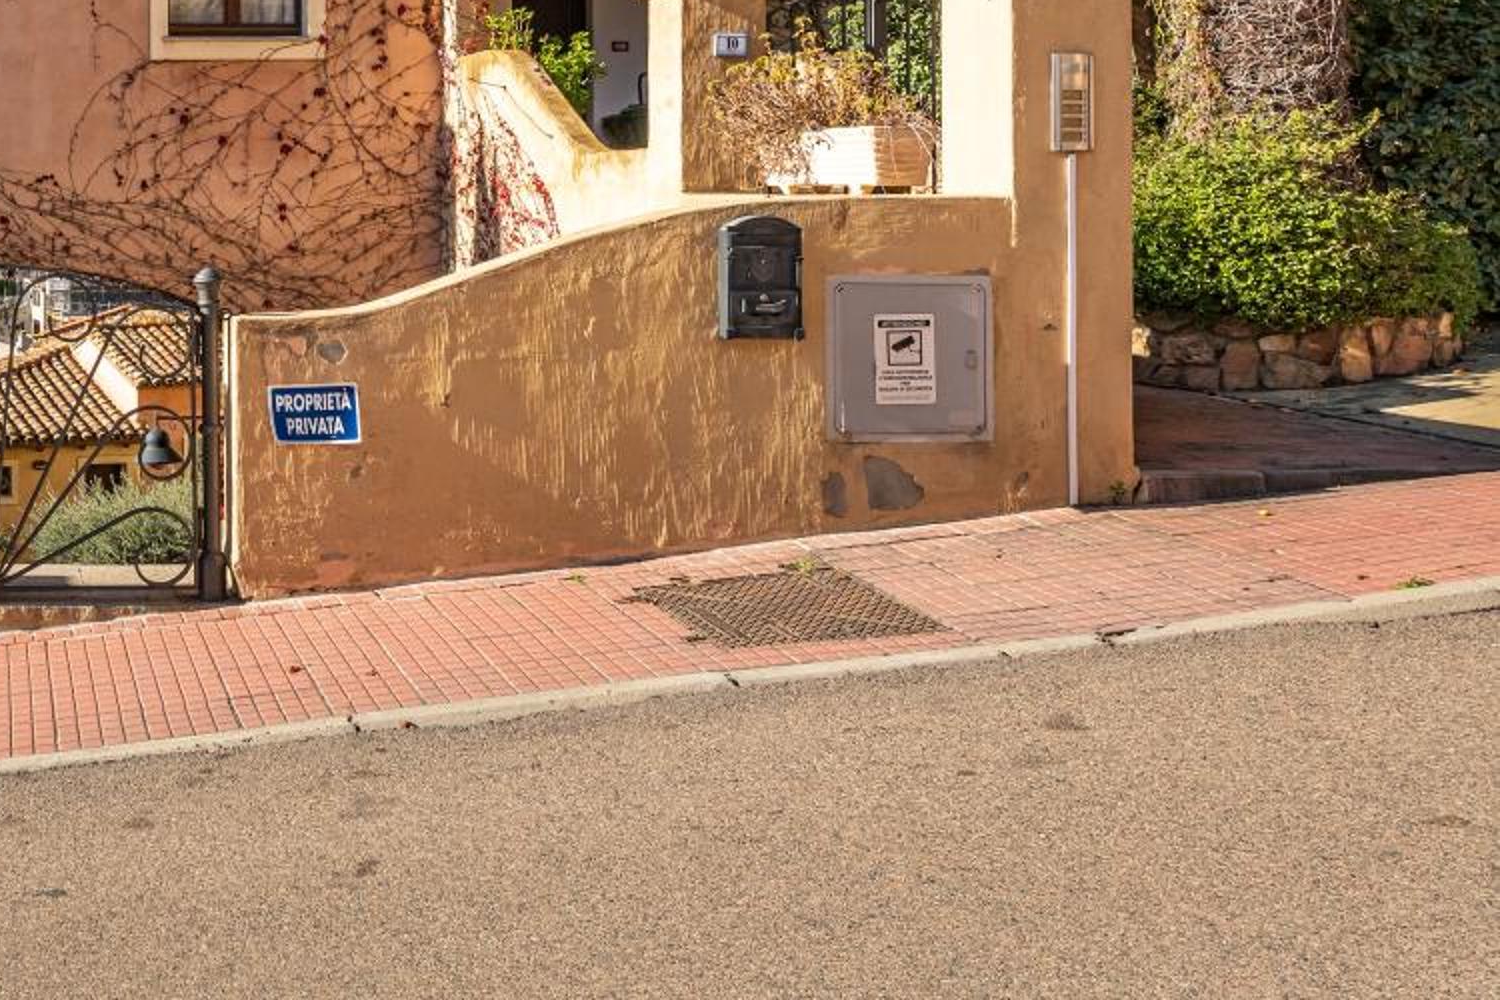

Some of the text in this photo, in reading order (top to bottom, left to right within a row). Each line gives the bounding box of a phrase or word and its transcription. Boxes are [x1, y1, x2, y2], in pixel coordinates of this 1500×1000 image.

[727, 36, 739, 49] 10
[275, 387, 352, 412] PROPRIETÀ
[286, 416, 345, 435] PRIVATA
